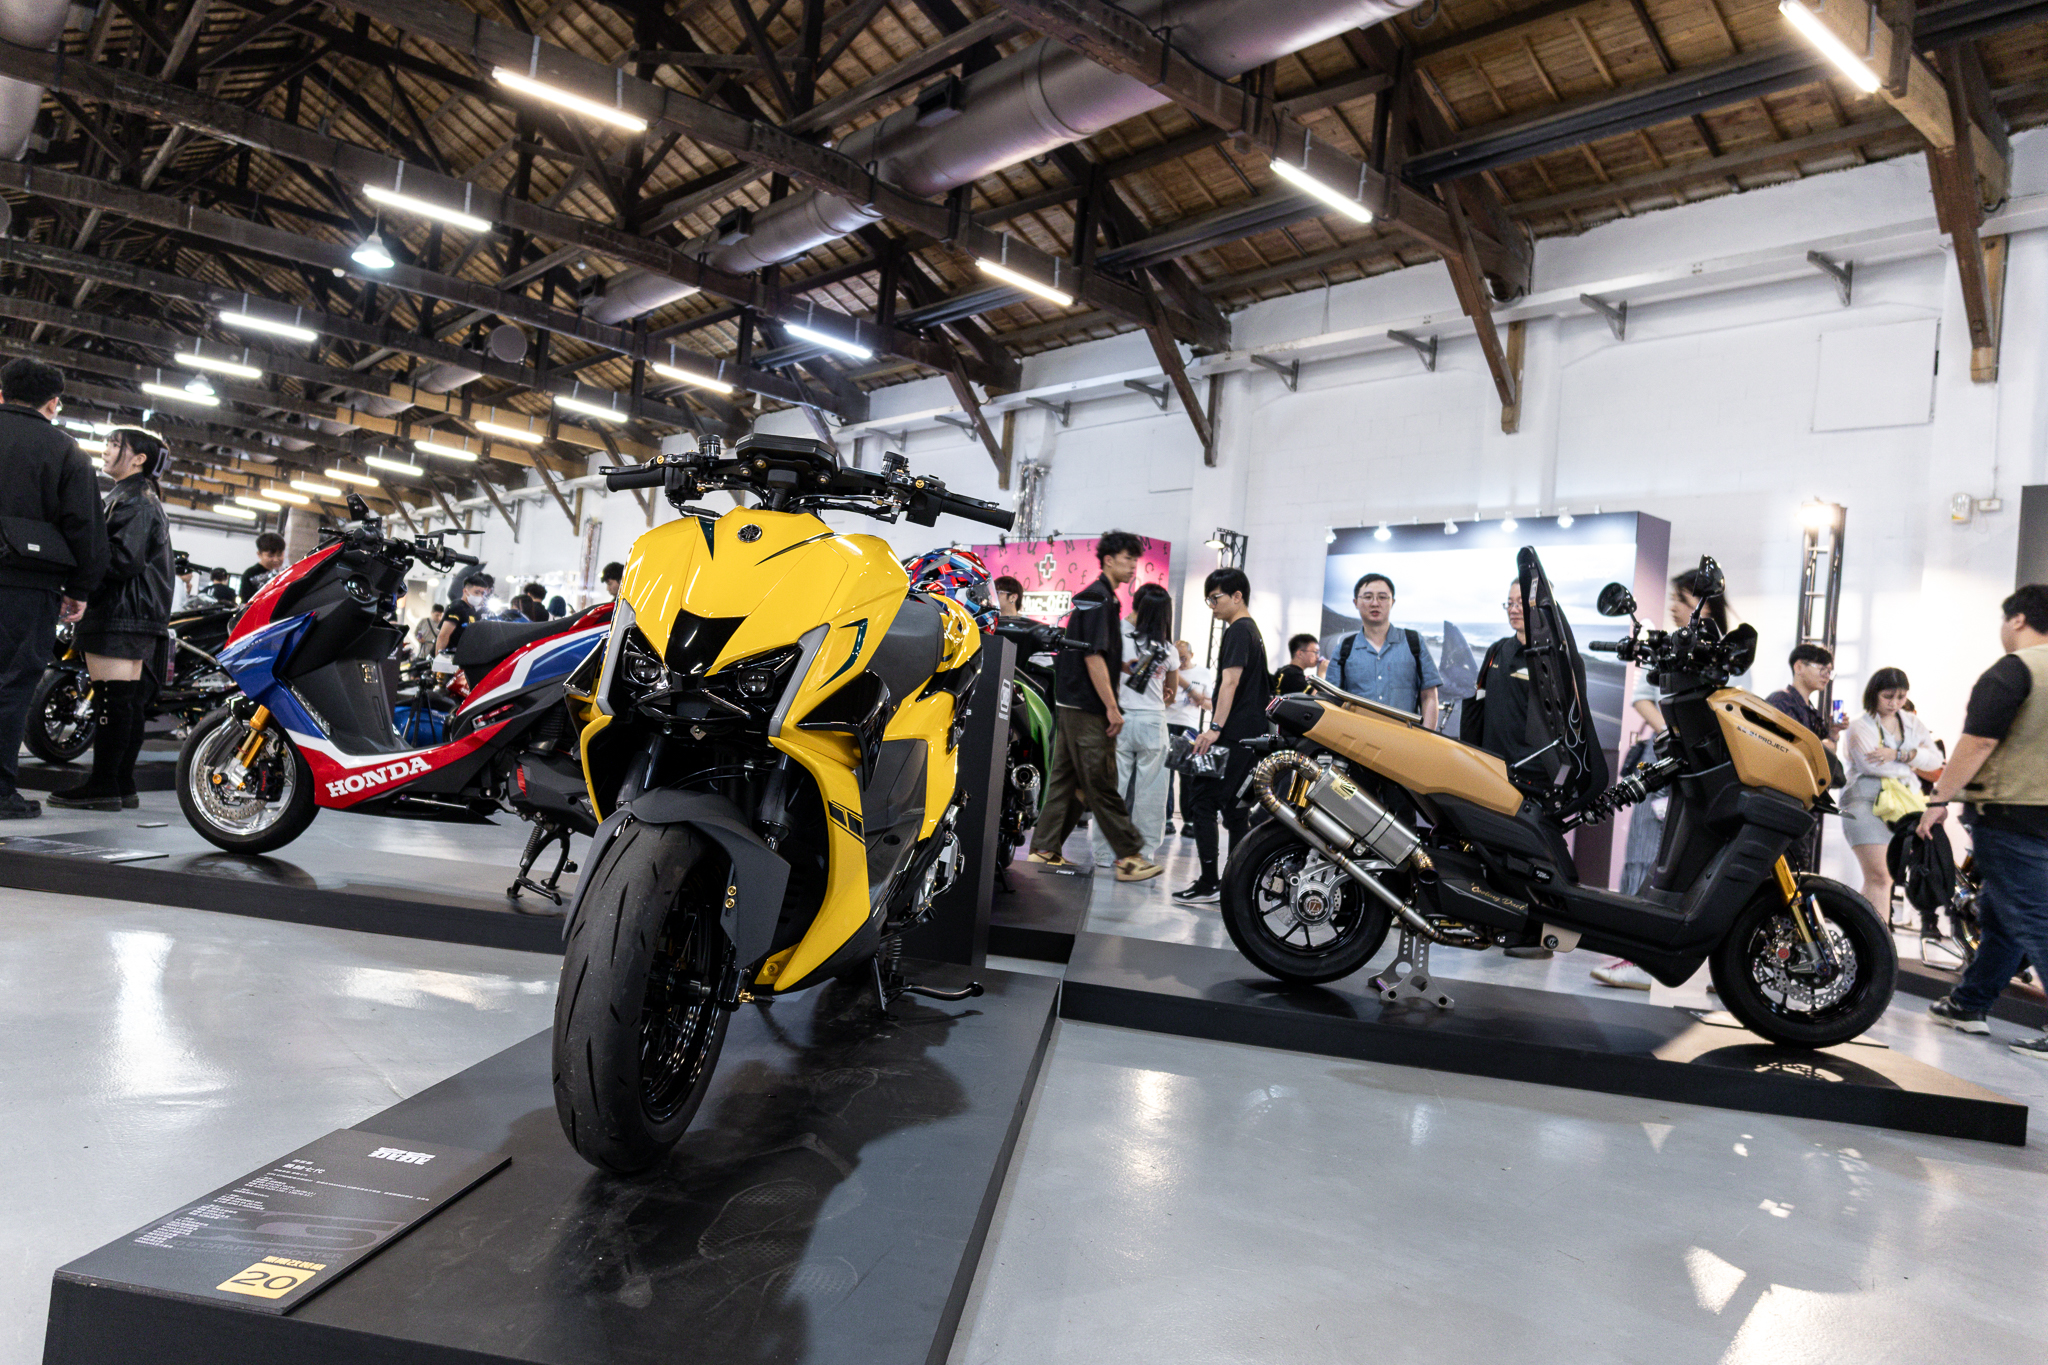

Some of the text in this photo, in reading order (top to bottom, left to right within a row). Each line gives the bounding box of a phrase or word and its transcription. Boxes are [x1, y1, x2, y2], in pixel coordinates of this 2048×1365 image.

[1022, 594, 1069, 613] Muc-Off
[1758, 734, 1789, 753] PROJECT
[325, 756, 432, 798] HONDA
[230, 1270, 298, 1290] 20
